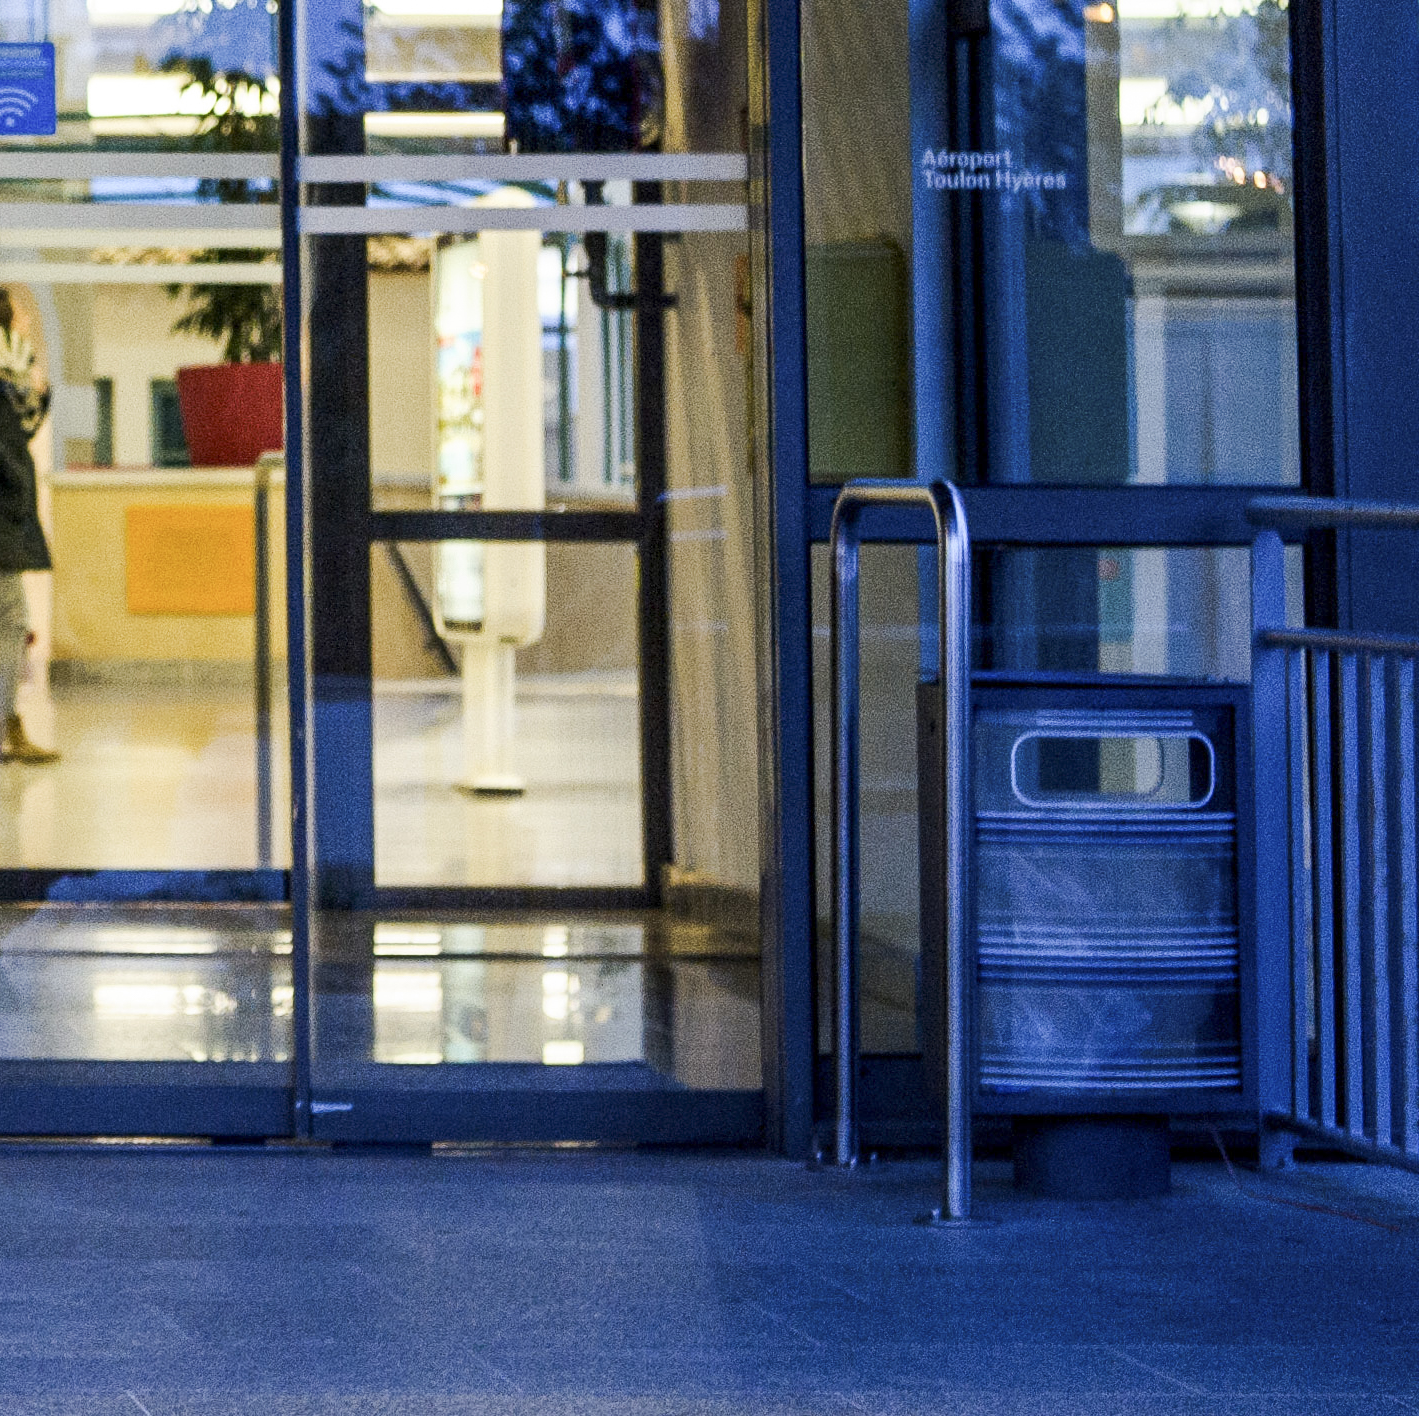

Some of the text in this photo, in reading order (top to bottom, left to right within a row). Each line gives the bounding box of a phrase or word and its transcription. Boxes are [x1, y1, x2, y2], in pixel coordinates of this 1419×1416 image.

[923, 148, 1012, 171] Aéroport
[923, 168, 1067, 193] Toulon Hyères
